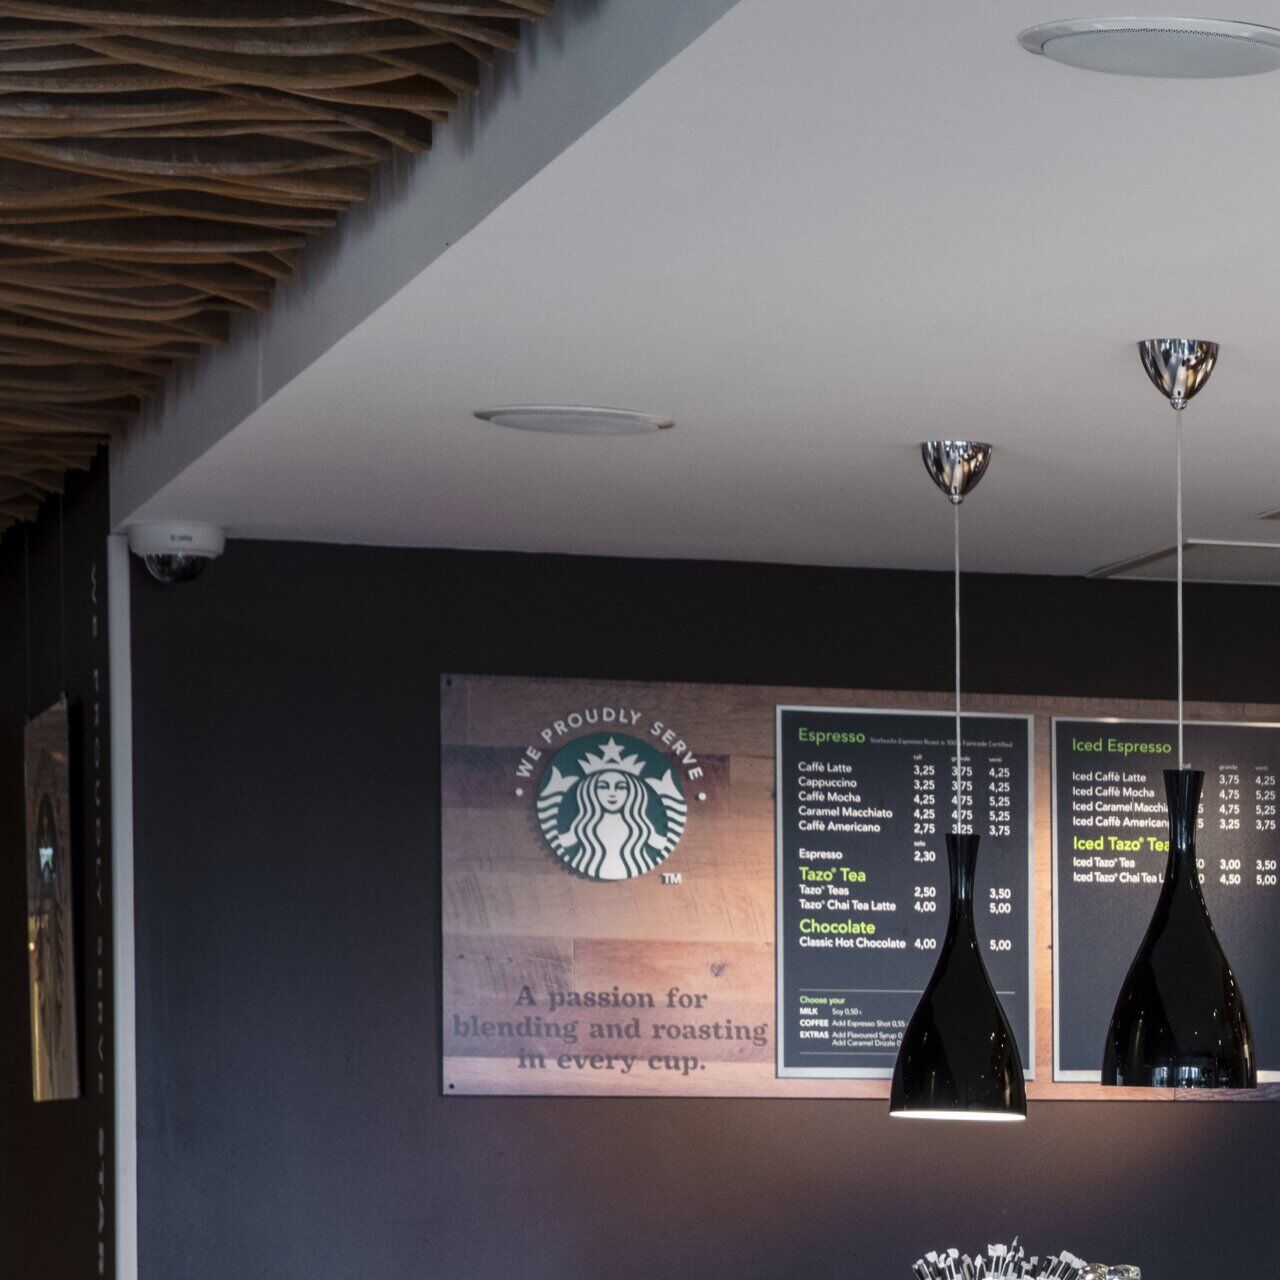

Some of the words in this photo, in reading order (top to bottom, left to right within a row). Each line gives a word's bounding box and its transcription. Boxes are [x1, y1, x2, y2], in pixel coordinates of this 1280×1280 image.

[516, 746, 542, 777] WE
[541, 707, 642, 744] PROUDLY
[650, 721, 704, 780] SERVE
[799, 727, 866, 746] Espresso
[1073, 737, 1103, 752] Iced
[1108, 739, 1172, 757] Espresso
[798, 761, 825, 772] Caffè
[827, 762, 853, 773] Latte
[913, 765, 935, 776] 3,25
[989, 767, 1010, 778] 4,25
[798, 776, 857, 789] Cappuccino
[913, 780, 935, 791] 3,25
[989, 782, 1010, 793] 4,25
[1072, 771, 1093, 781] Iced
[1095, 771, 1120, 781] Caffè
[1122, 772, 1147, 782] Latte
[1219, 775, 1240, 785] 3,75
[1255, 776, 1276, 786] 4,25
[798, 791, 825, 801] Caffè
[827, 792, 861, 803] Mocha
[913, 794, 935, 805] 4,25
[989, 796, 1010, 807] 5,25
[1072, 786, 1093, 796] Iced
[1095, 786, 1120, 796] Caffè
[1122, 787, 1155, 797] Mocha
[1219, 789, 1240, 800] 4,75
[1255, 790, 1276, 801] 5,25
[798, 805, 840, 816] Caramel
[842, 806, 893, 818] Macchiato
[913, 809, 935, 820] 4,25
[989, 811, 1010, 822] 5,25
[1072, 801, 1093, 811] Iced
[1095, 801, 1133, 812] Caramel
[1219, 804, 1240, 815] 4,75
[1255, 805, 1276, 815] 5,25
[798, 820, 825, 831] Caffè
[827, 821, 881, 832] Americano
[913, 823, 935, 834] 2,75
[989, 825, 1011, 836] 3,75
[1073, 816, 1093, 826] Iced
[1095, 816, 1121, 827] Caffè
[1219, 819, 1240, 830] 3,25
[1255, 820, 1276, 831] 3,75
[1073, 835, 1104, 850] Iced
[799, 848, 843, 861] Espresso
[914, 851, 936, 863] 2,30
[1073, 857, 1093, 867] Iced
[1119, 857, 1136, 868] Tea
[1220, 859, 1241, 870] 3,00
[1256, 860, 1277, 871] 3,50
[840, 867, 866, 882] Tea
[1073, 871, 1093, 882] Iced
[1119, 872, 1140, 883] Chai
[1141, 872, 1157, 883] Tea
[1220, 874, 1241, 885] 4,50
[1256, 875, 1277, 886] 5,00
[827, 884, 850, 896] Teas
[914, 887, 936, 898] 2,50
[989, 888, 1011, 900] 3,50
[827, 899, 850, 910] Chai
[852, 900, 869, 911] Tea
[871, 900, 896, 911] Latte
[914, 901, 936, 912] 4,00
[989, 903, 1011, 914] 5,00
[799, 918, 876, 934] Chocolate
[799, 936, 833, 947] Classic
[835, 937, 854, 948] Hot
[856, 937, 907, 949] Chocolate
[914, 938, 936, 950] 4,00
[990, 939, 1012, 951] 5,00
[515, 986, 537, 1007] A
[549, 988, 655, 1011] passion
[666, 988, 708, 1009] for
[799, 996, 828, 1005] Choose
[829, 997, 846, 1006] your
[799, 1007, 818, 1015] MILK
[832, 1008, 844, 1016] Soy
[453, 1014, 579, 1044] blending
[589, 1018, 641, 1039] and
[651, 1020, 769, 1047] roasting
[799, 1019, 829, 1027] COFFEE
[847, 1020, 875, 1028] Espresso
[799, 1031, 829, 1039] EXTRAS
[847, 1031, 878, 1039] Flavoured
[879, 1032, 897, 1040] Syrup
[847, 1039, 874, 1047] Caramel
[875, 1039, 895, 1047] Drizzle
[517, 1048, 546, 1068] in
[556, 1052, 637, 1074] every
[648, 1055, 707, 1076] cup.
